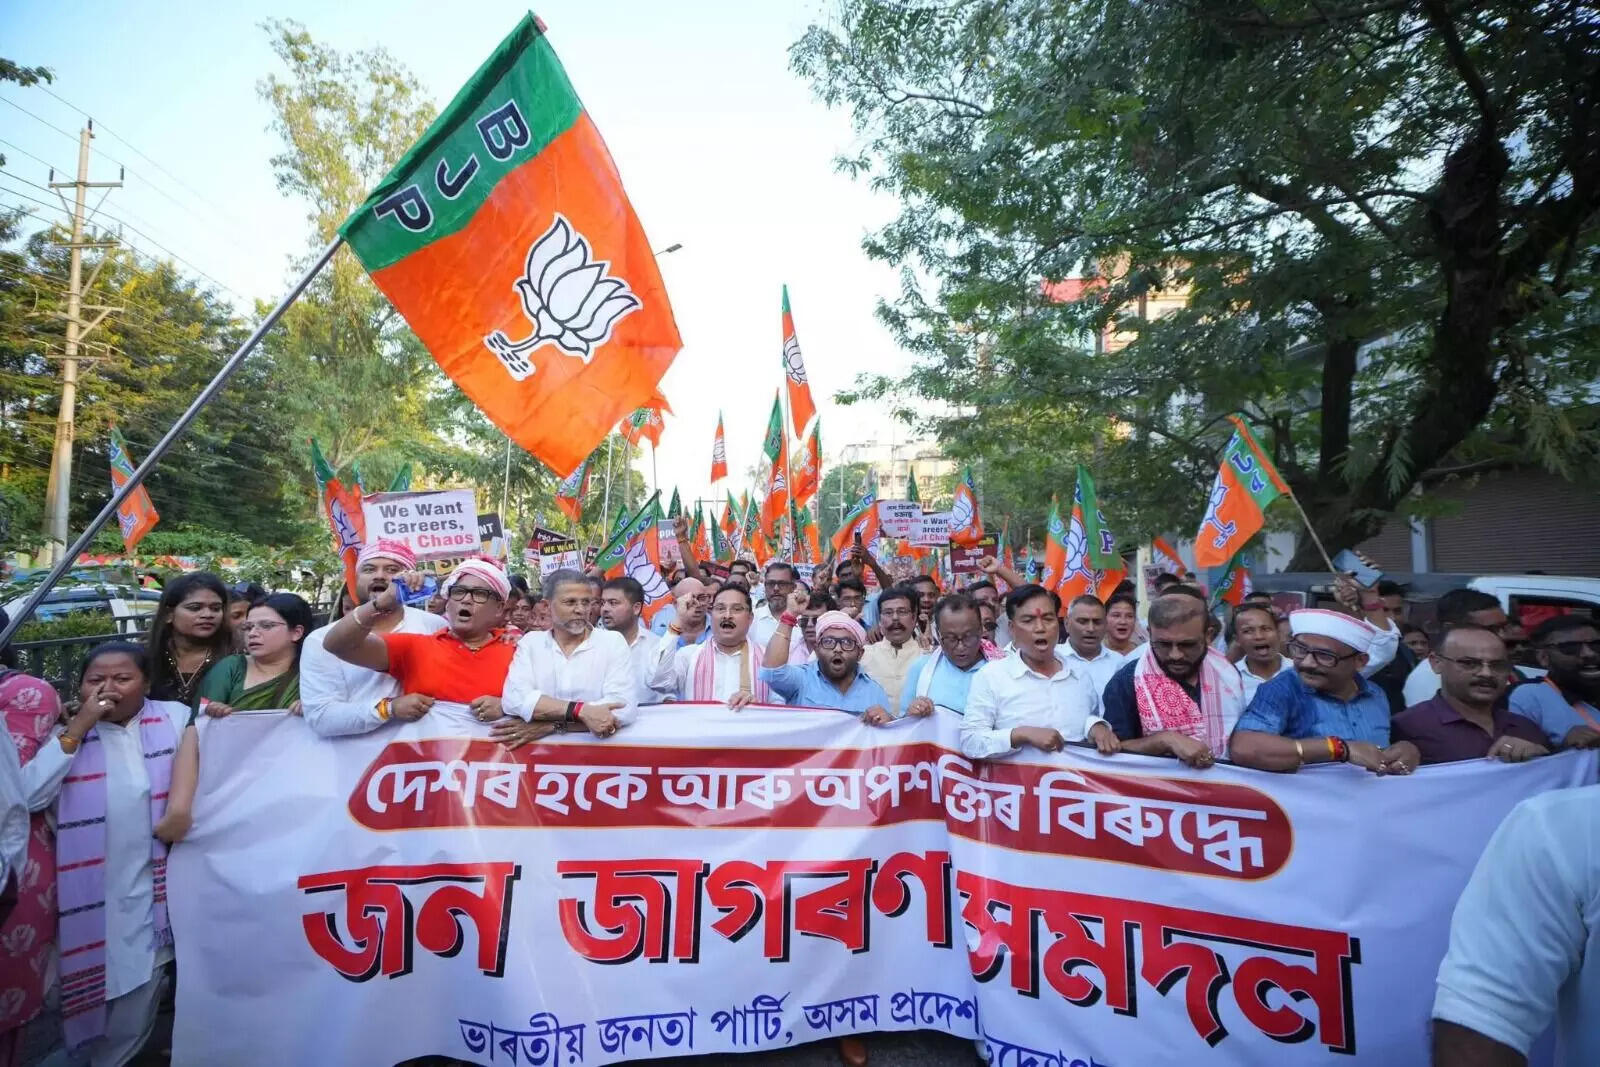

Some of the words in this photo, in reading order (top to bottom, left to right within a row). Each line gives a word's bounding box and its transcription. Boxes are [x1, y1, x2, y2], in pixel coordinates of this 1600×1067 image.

[379, 504, 409, 518] We
[415, 501, 464, 516] Want
[384, 519, 464, 534] Careers,
[417, 533, 475, 548] Chaos
[366, 760, 527, 816] দেশৰ
[534, 765, 652, 816] হকে
[658, 765, 798, 816] আৰু
[1034, 771, 1267, 873] বিৰুদ্ধে
[298, 861, 521, 982] জন
[557, 850, 952, 964] জাগৰণ
[459, 1013, 585, 1067] ভাৰতীয়
[598, 1010, 698, 1055] জনতা
[802, 993, 878, 1030] অসম
